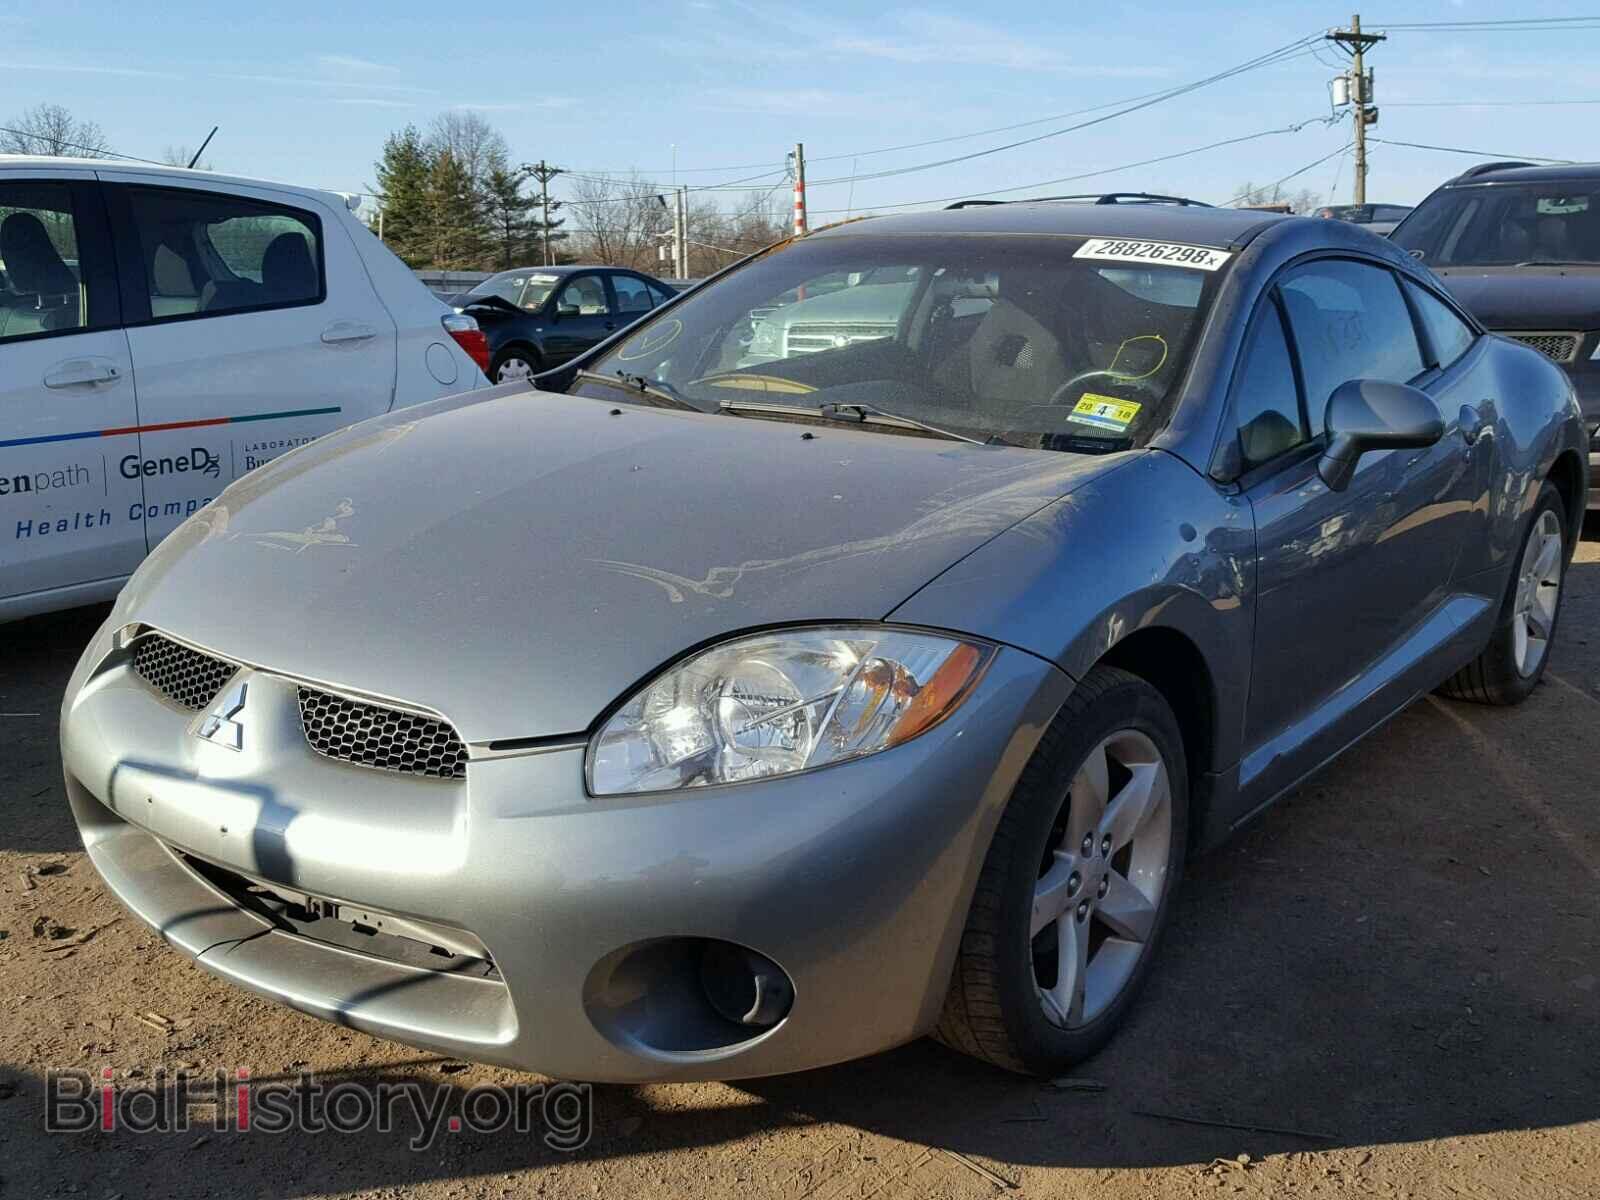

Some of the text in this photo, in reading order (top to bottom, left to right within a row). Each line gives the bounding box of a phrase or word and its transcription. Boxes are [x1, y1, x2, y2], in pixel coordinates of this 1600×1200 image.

[1078, 402, 1094, 411] 20
[1097, 405, 1108, 416] 4
[16, 508, 111, 539] Health
